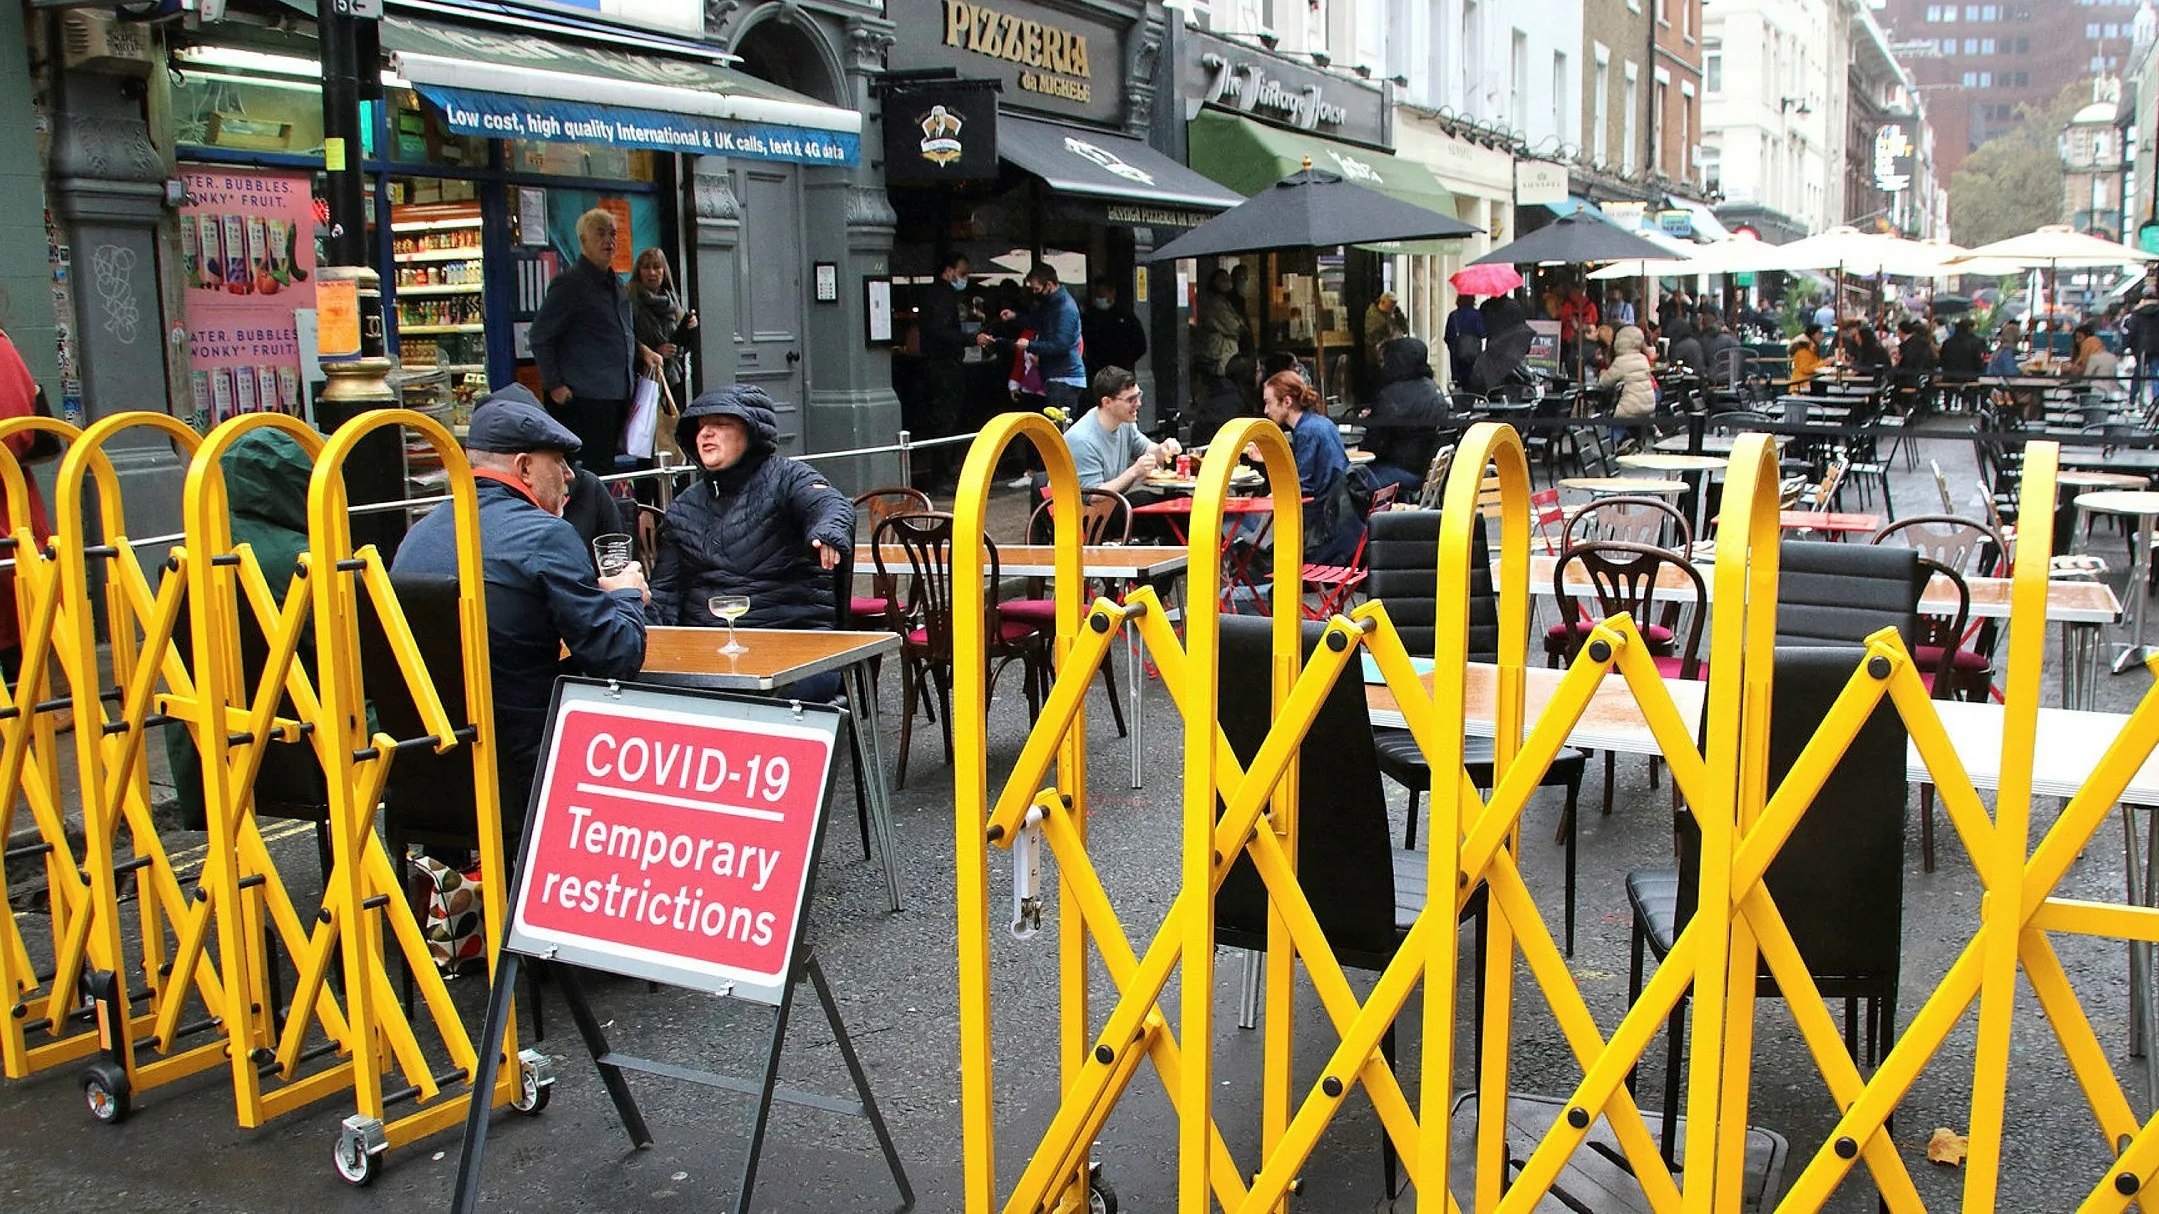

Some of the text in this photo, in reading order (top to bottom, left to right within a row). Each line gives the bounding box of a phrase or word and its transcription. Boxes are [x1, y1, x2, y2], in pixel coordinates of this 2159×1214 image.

[946, 0, 1091, 78] PIZZERIA
[1022, 70, 1038, 91] da
[446, 103, 845, 160] Low cost, high quality International & UK calls, text & 4G data
[225, 178, 294, 194] BUBBLES.
[241, 194, 287, 209] FRUIT.
[253, 344, 297, 355] FRUIT.
[586, 732, 790, 803] COVID-19
[567, 805, 780, 892] Temporary
[541, 872, 776, 947] restrictions
